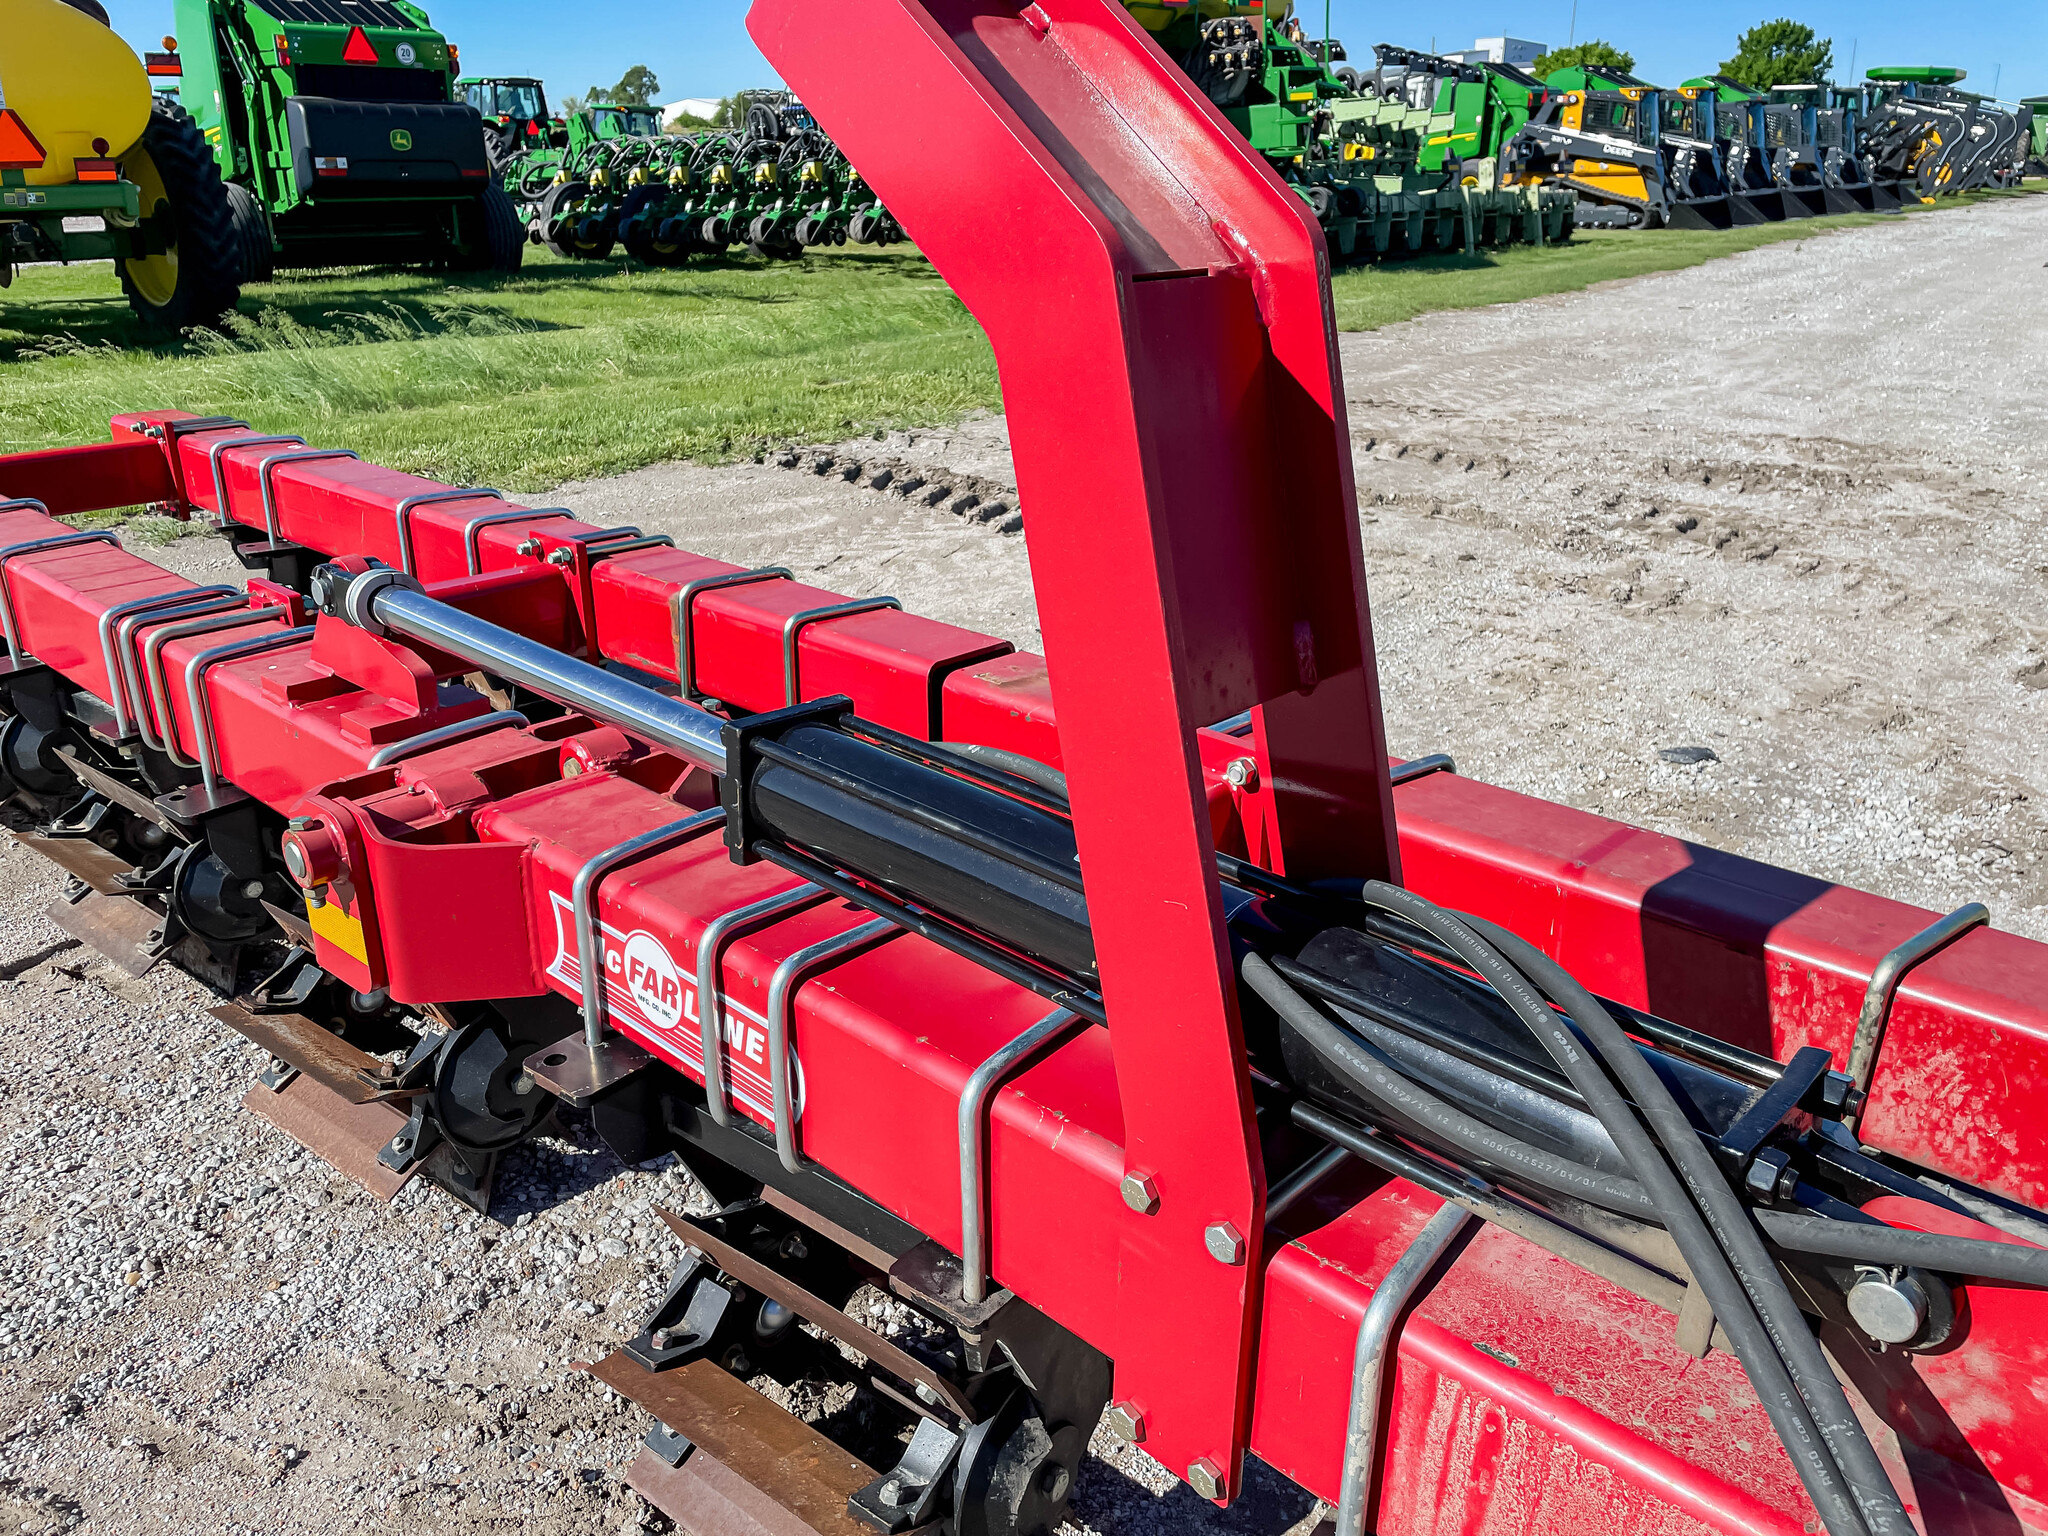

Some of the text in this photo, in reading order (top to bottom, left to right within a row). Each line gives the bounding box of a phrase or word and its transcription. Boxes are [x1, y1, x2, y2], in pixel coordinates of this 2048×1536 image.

[400, 48, 411, 57] 20
[1603, 144, 1634, 158] DEERE
[1502, 972, 1513, 982] 12
[1333, 1042, 1370, 1073] Ryco
[1436, 1113, 1450, 1125] 12
[1808, 1450, 1833, 1486] RYCO
